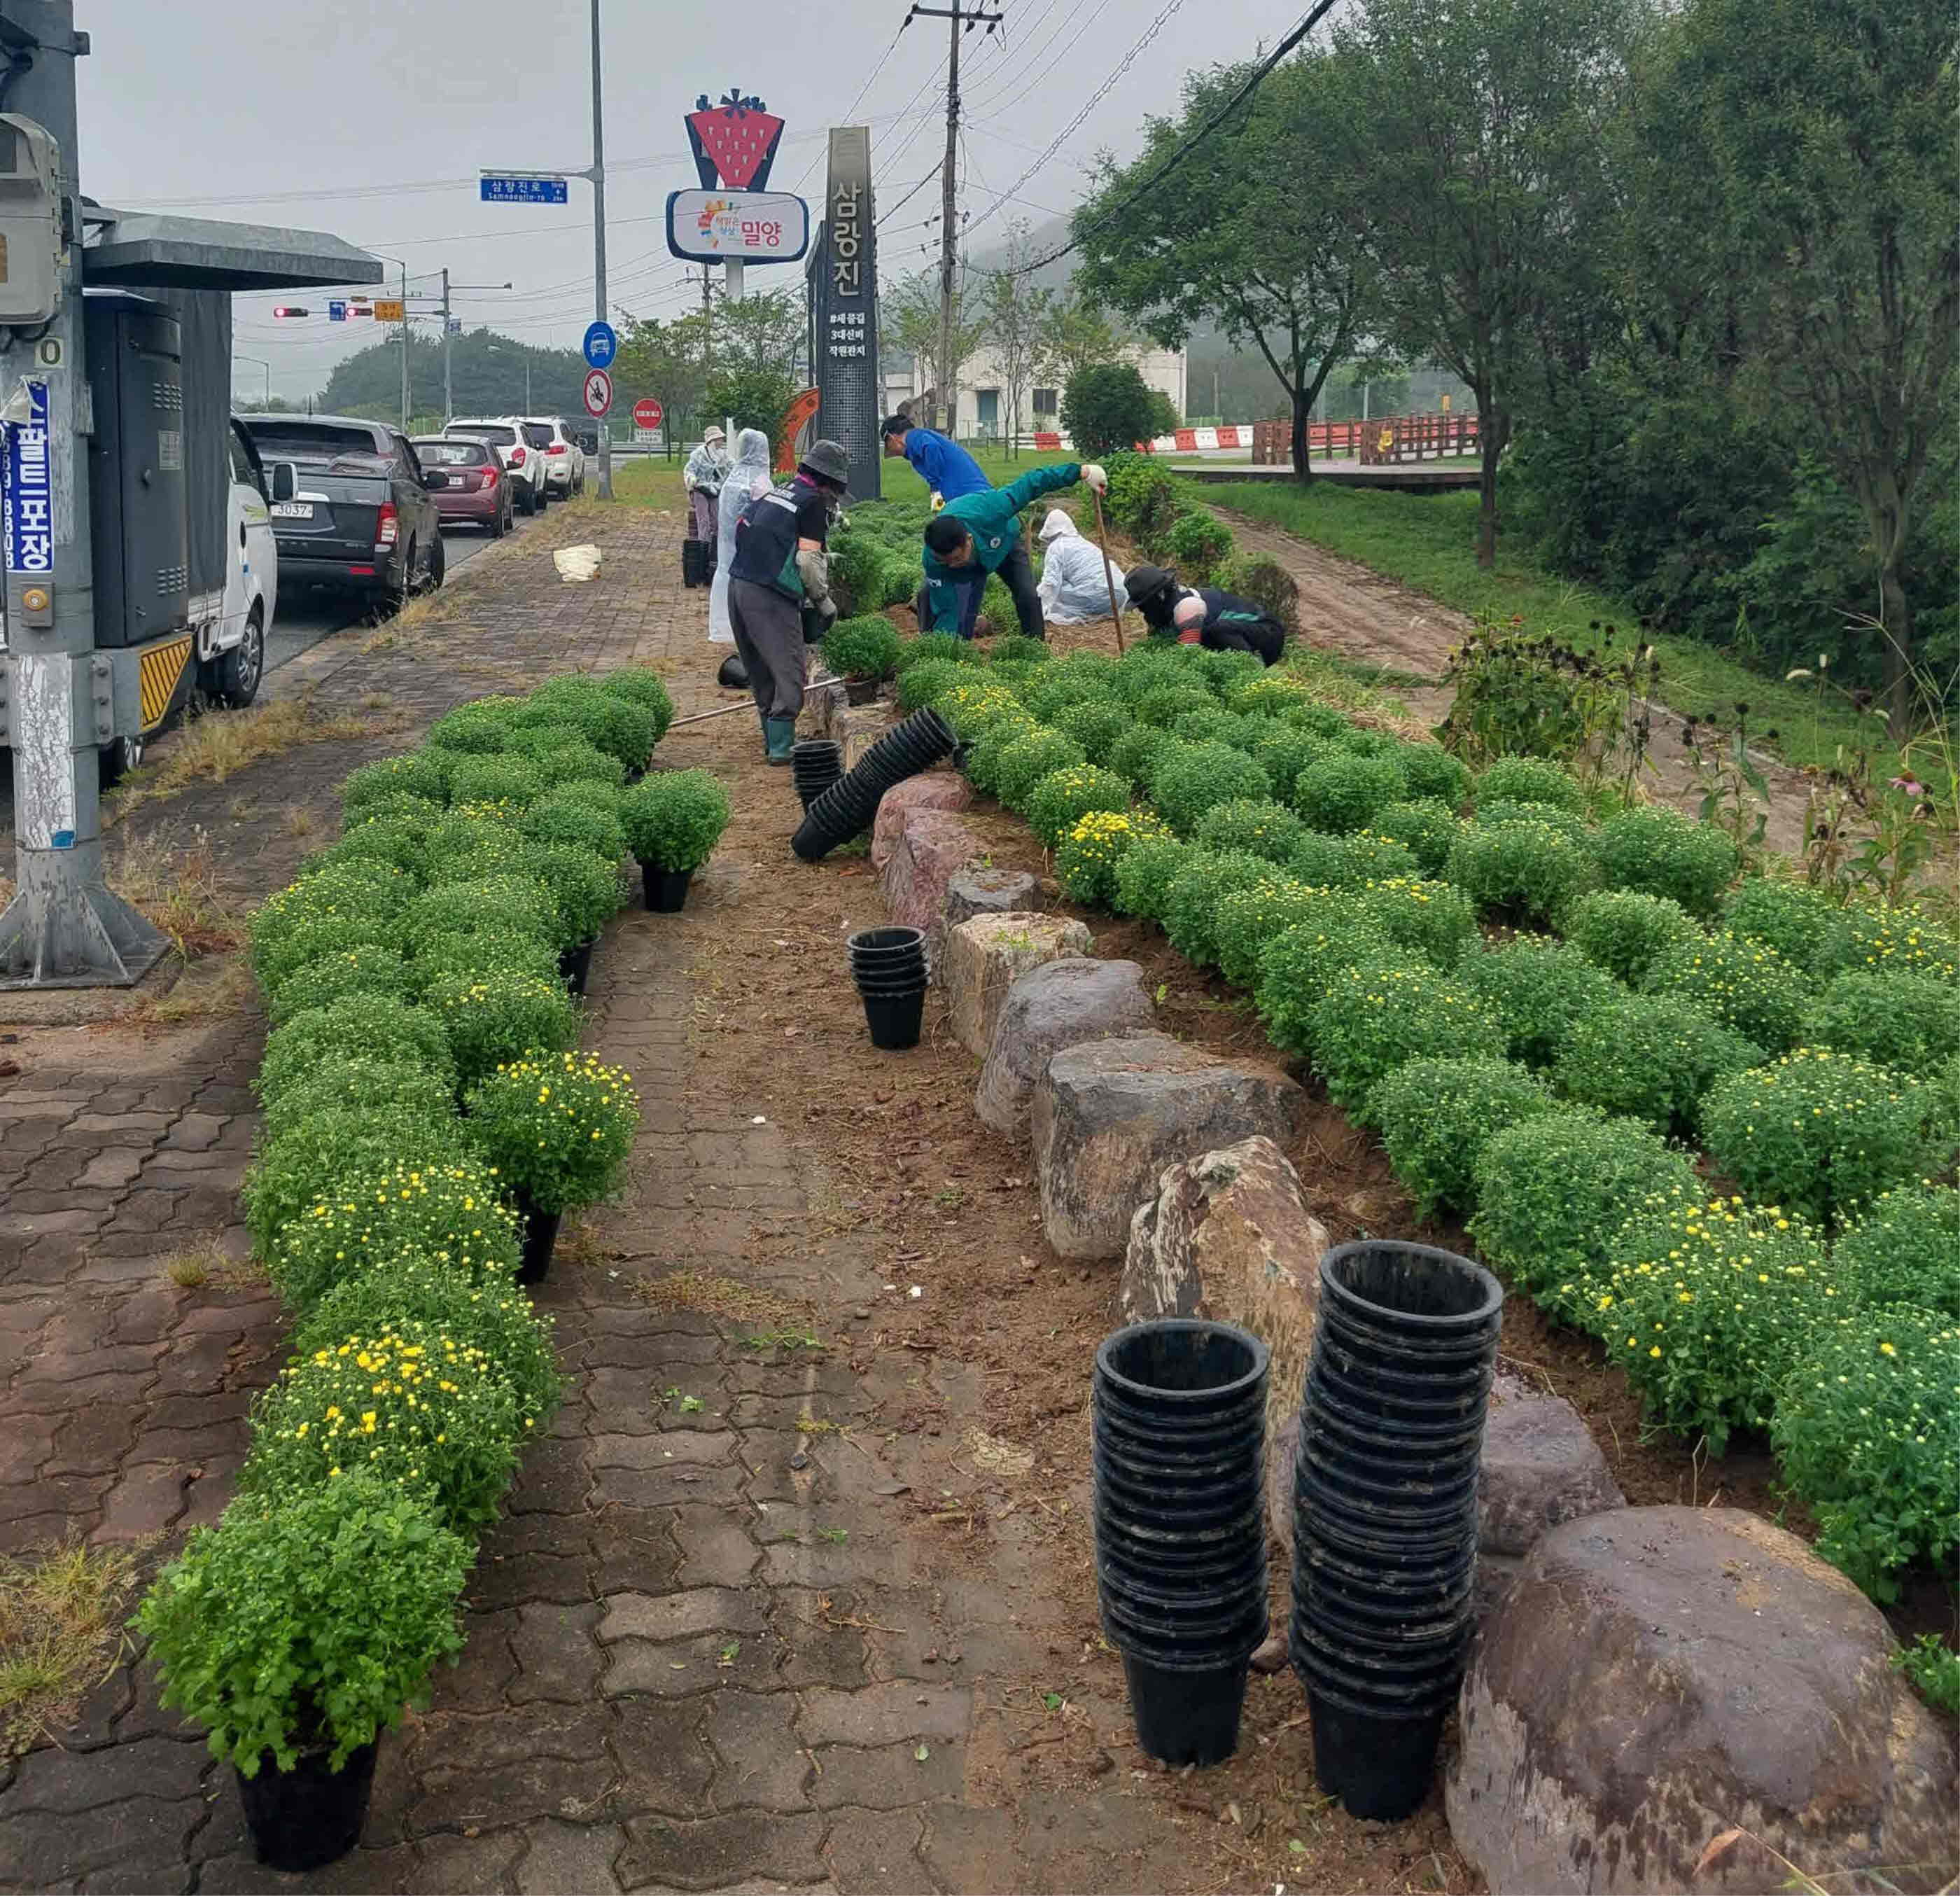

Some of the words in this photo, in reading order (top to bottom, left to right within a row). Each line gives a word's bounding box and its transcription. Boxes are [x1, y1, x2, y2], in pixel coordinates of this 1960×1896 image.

[492, 181, 541, 193] 삼랑진로
[741, 220, 783, 247] 밀양
[832, 181, 862, 296] 삼랑진
